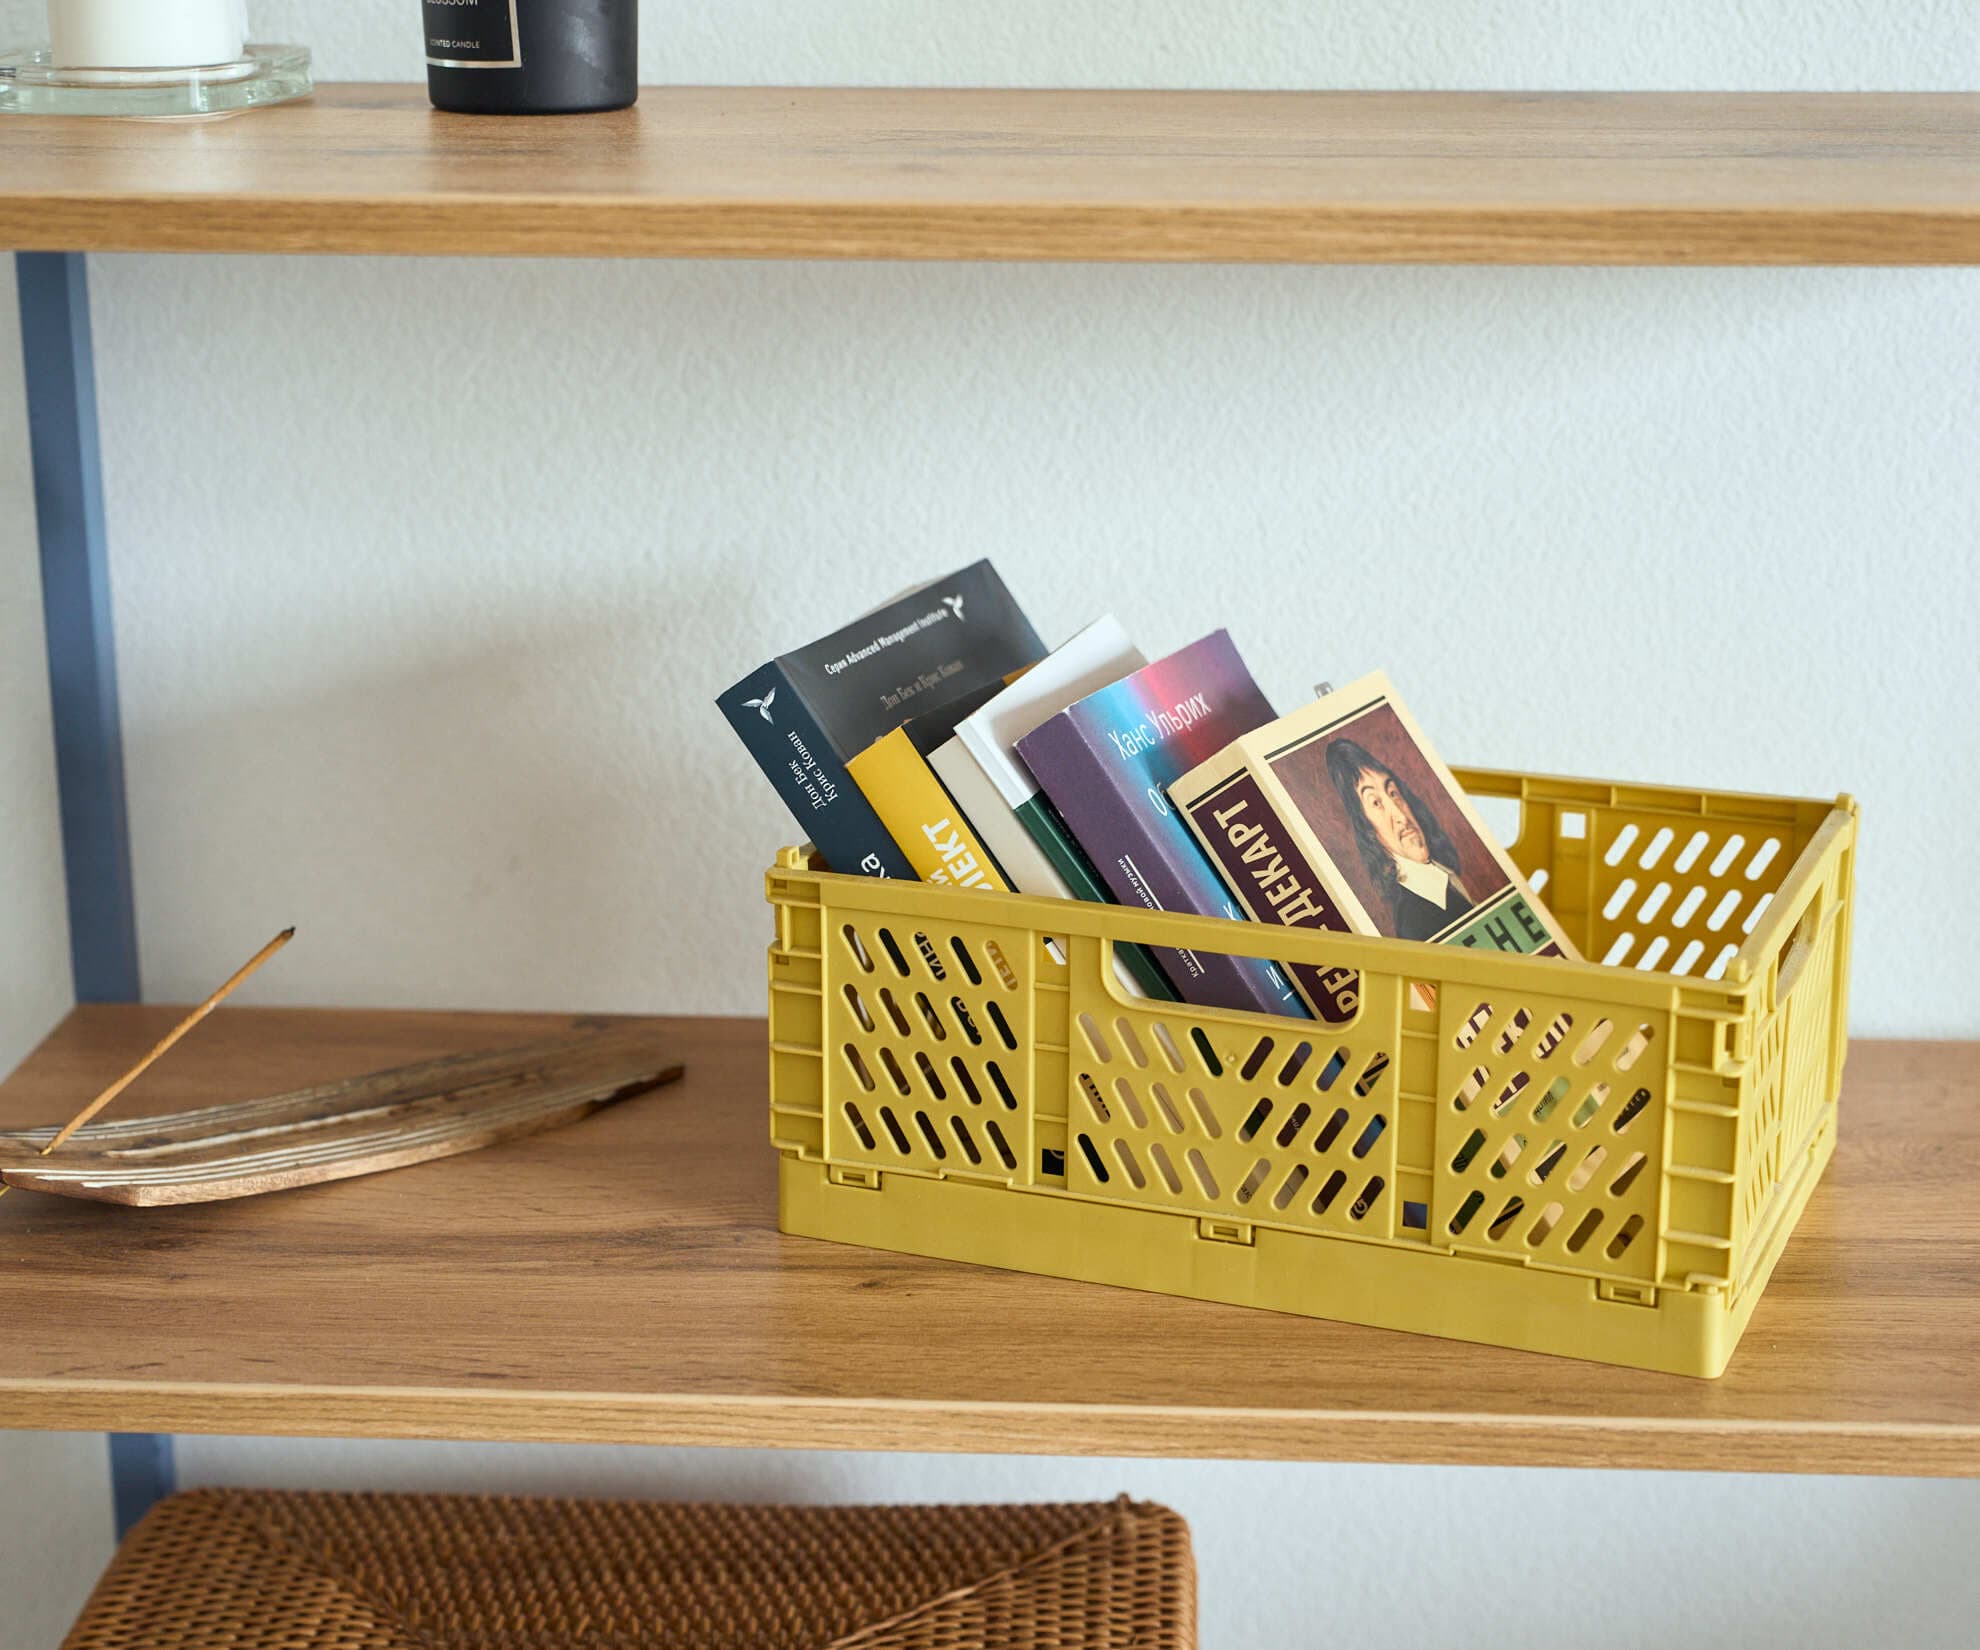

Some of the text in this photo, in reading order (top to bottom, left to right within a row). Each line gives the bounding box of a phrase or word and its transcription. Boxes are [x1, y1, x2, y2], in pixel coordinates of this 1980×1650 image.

[451, 40, 480, 49] CANDLE
[846, 640, 881, 665] Advanced
[878, 621, 921, 648] Management
[1107, 692, 1212, 760] Ханс Ульрих
[787, 731, 839, 802] Крис Кован
[788, 759, 828, 810] Дон Бек
[1213, 799, 1325, 926] ДЕКАРТ
[1462, 902, 1546, 953] НЕ
